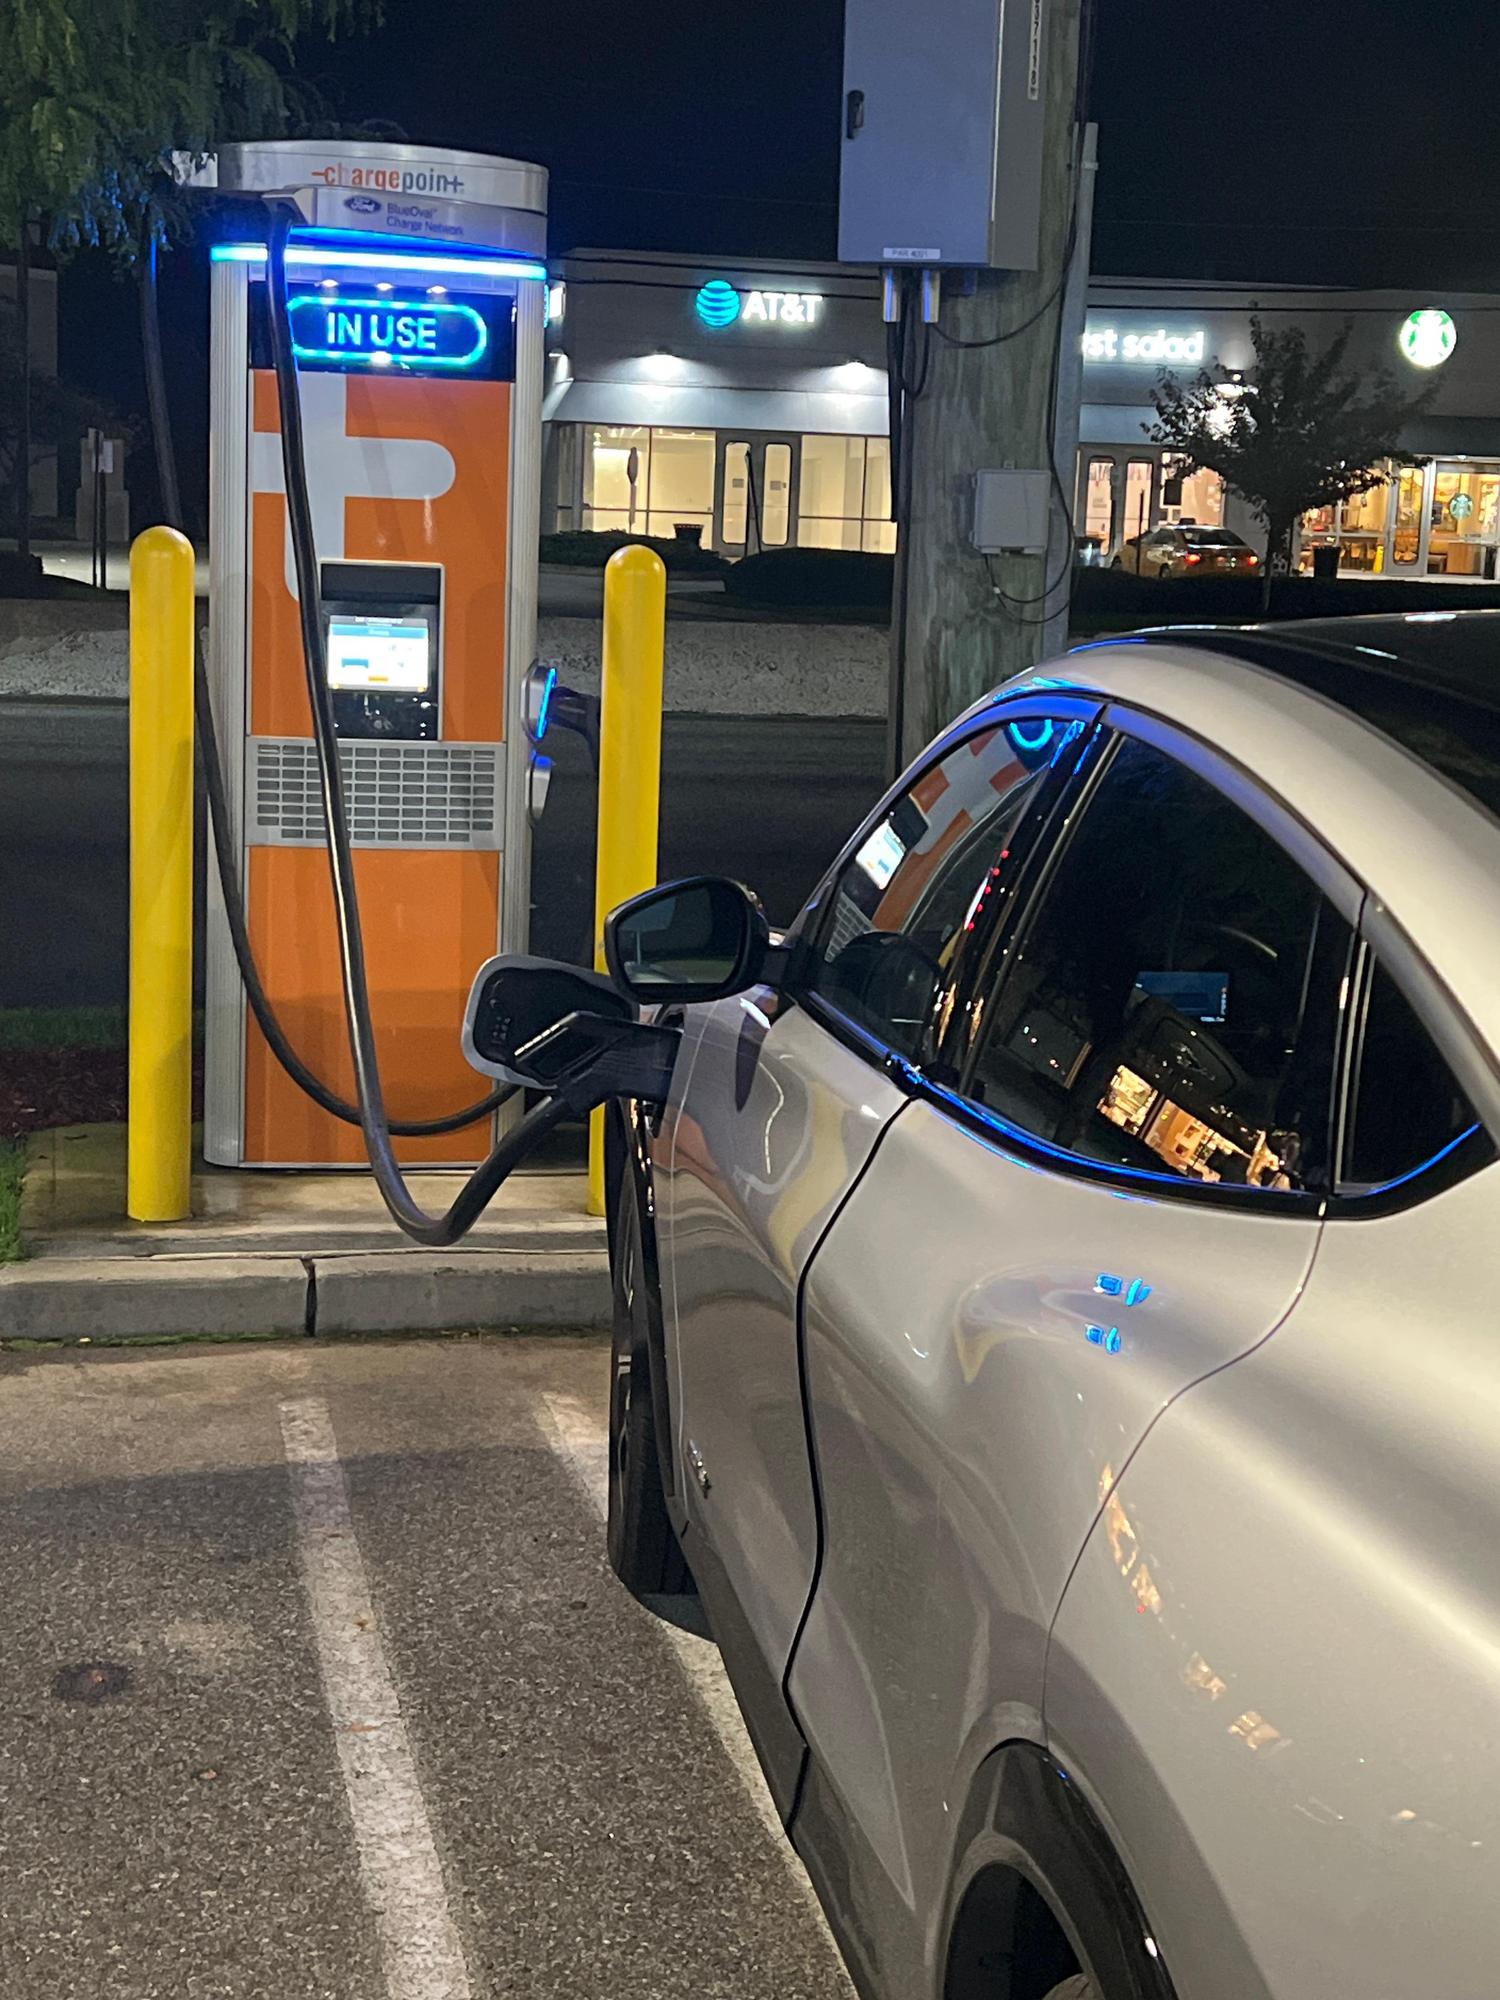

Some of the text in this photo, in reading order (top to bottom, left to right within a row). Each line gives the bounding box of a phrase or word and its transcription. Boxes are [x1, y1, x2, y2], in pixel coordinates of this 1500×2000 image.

[386, 215, 464, 234] Charge Network
[742, 291, 823, 322] AT&T
[328, 312, 436, 350] IN USE
[1122, 329, 1204, 360] salad
